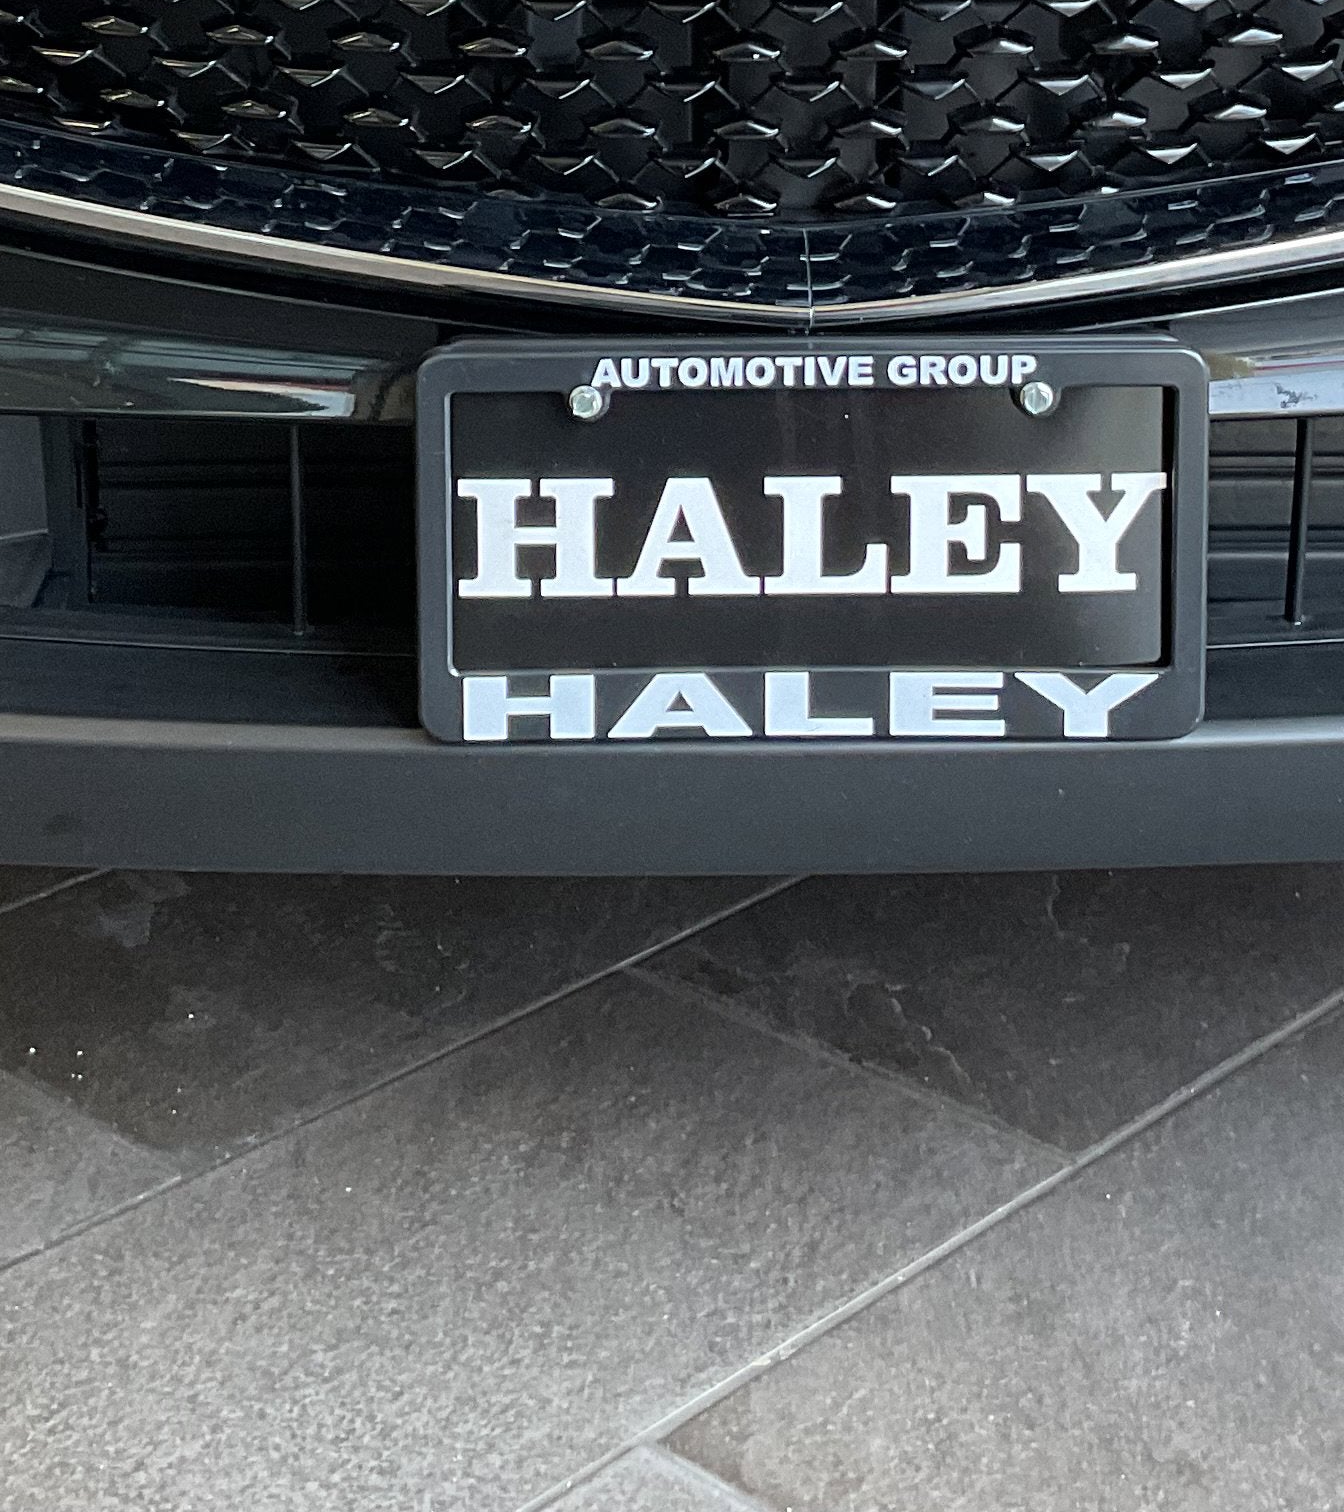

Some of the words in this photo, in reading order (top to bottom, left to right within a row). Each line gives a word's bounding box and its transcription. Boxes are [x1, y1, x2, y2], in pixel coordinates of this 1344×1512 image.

[591, 356, 874, 388] AUTOMOTIVE
[887, 354, 1037, 385] GROUP
[457, 472, 1167, 597] HALEY
[463, 671, 1159, 741] HALEY
